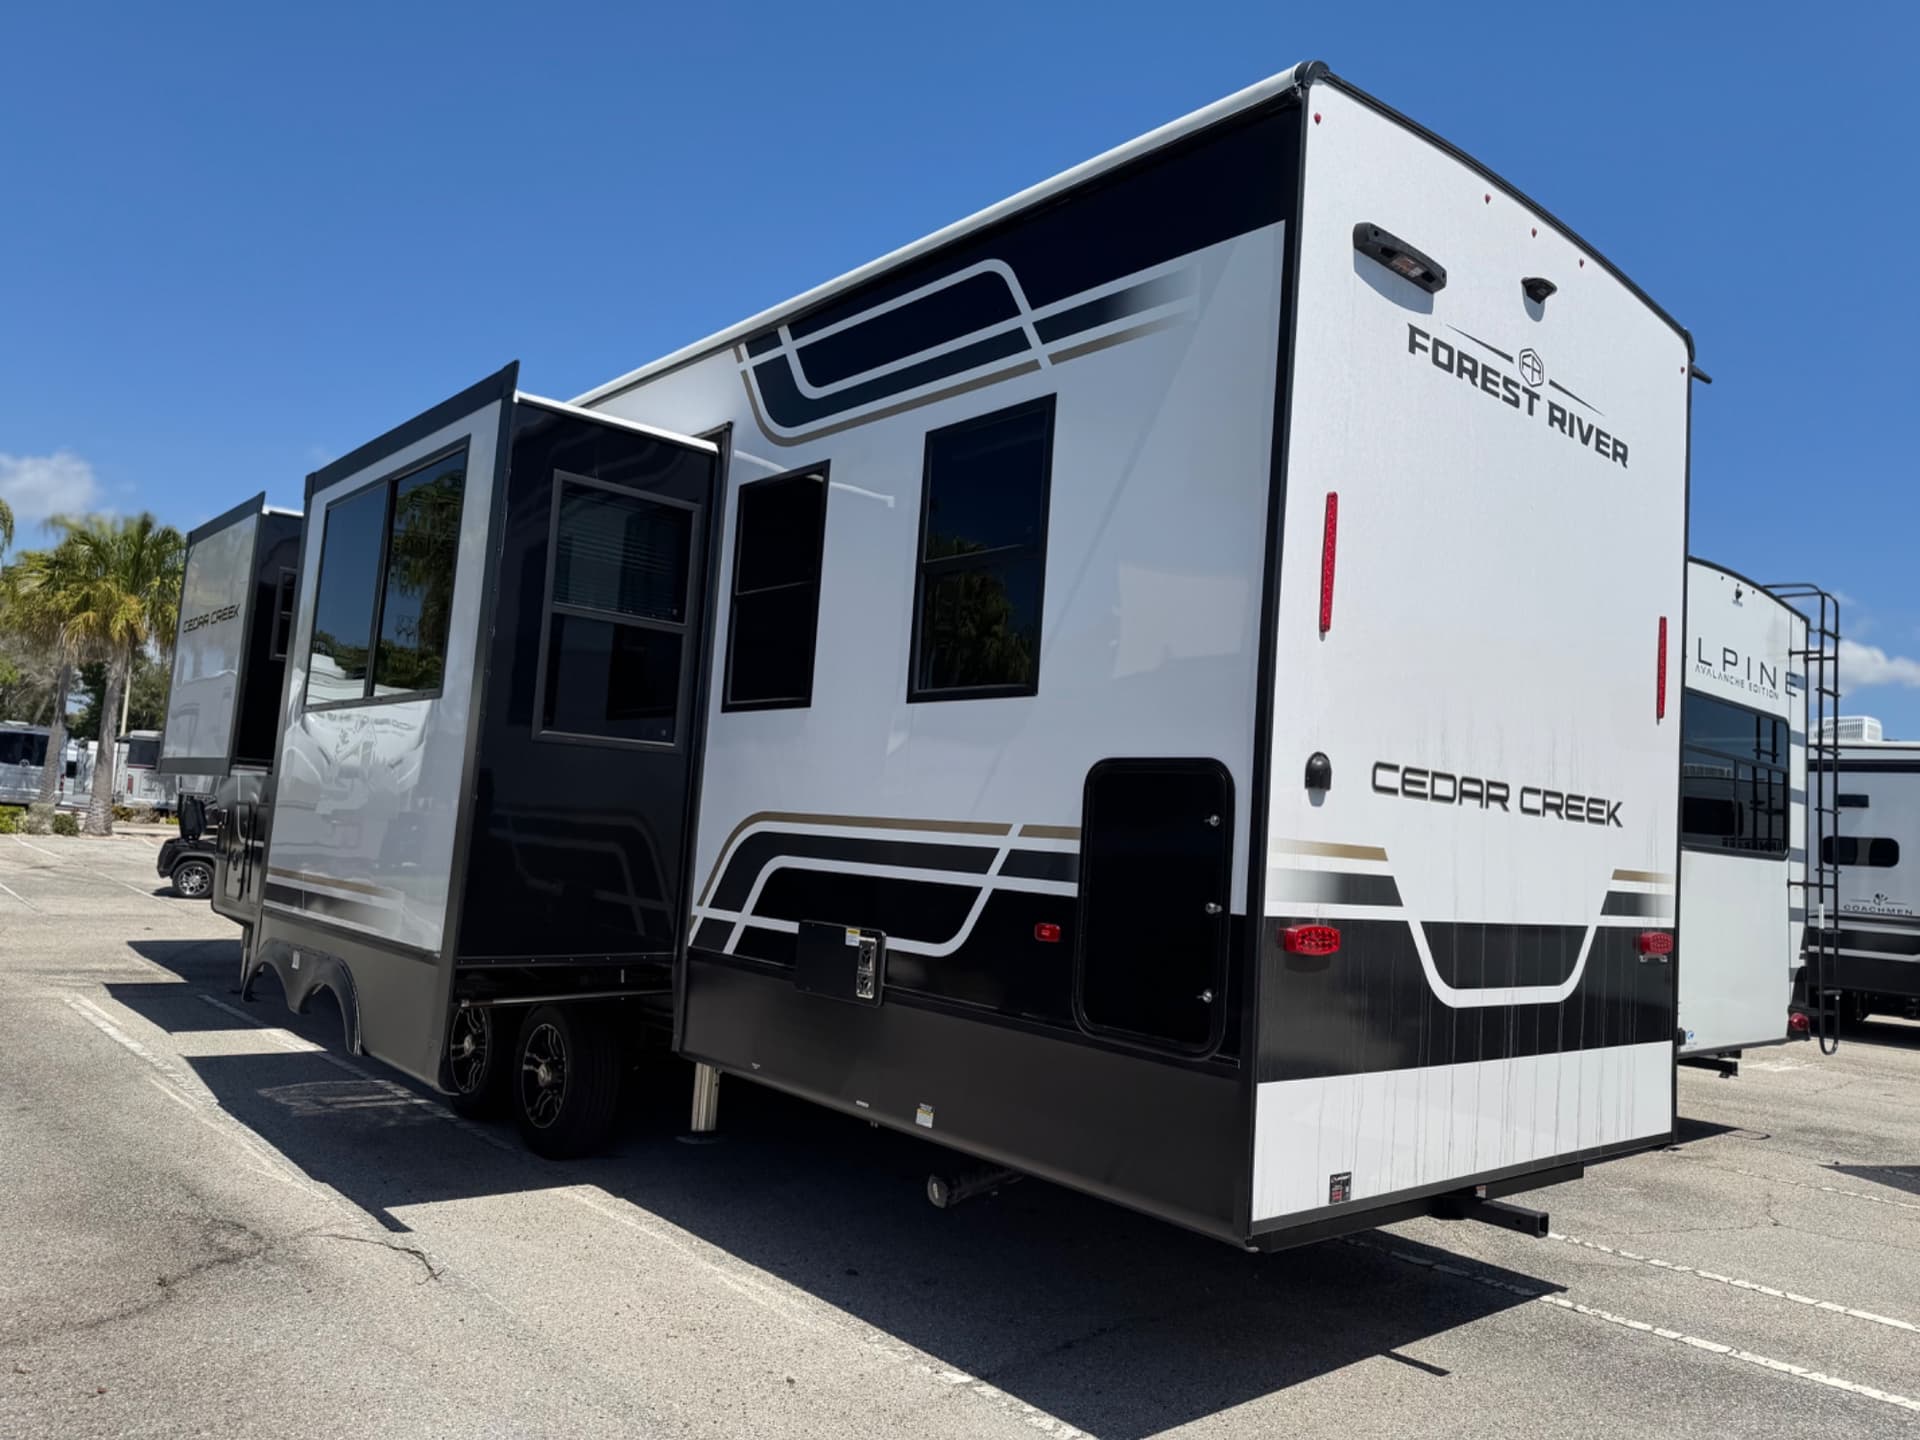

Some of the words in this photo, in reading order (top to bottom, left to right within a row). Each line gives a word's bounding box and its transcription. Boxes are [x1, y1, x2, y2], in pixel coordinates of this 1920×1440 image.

[1407, 322, 1541, 417] FOREST
[1547, 400, 1629, 469] RIVER
[183, 613, 209, 634] CEDAR
[210, 603, 241, 625] CREEK
[1694, 664, 1745, 689] AVALANCHE
[1748, 682, 1779, 700] EDITION
[1698, 636, 1798, 698] LPINE
[1371, 761, 1510, 813] CEDAR
[1519, 786, 1623, 828] CREEK
[1843, 904, 1913, 916] COACHMEN
